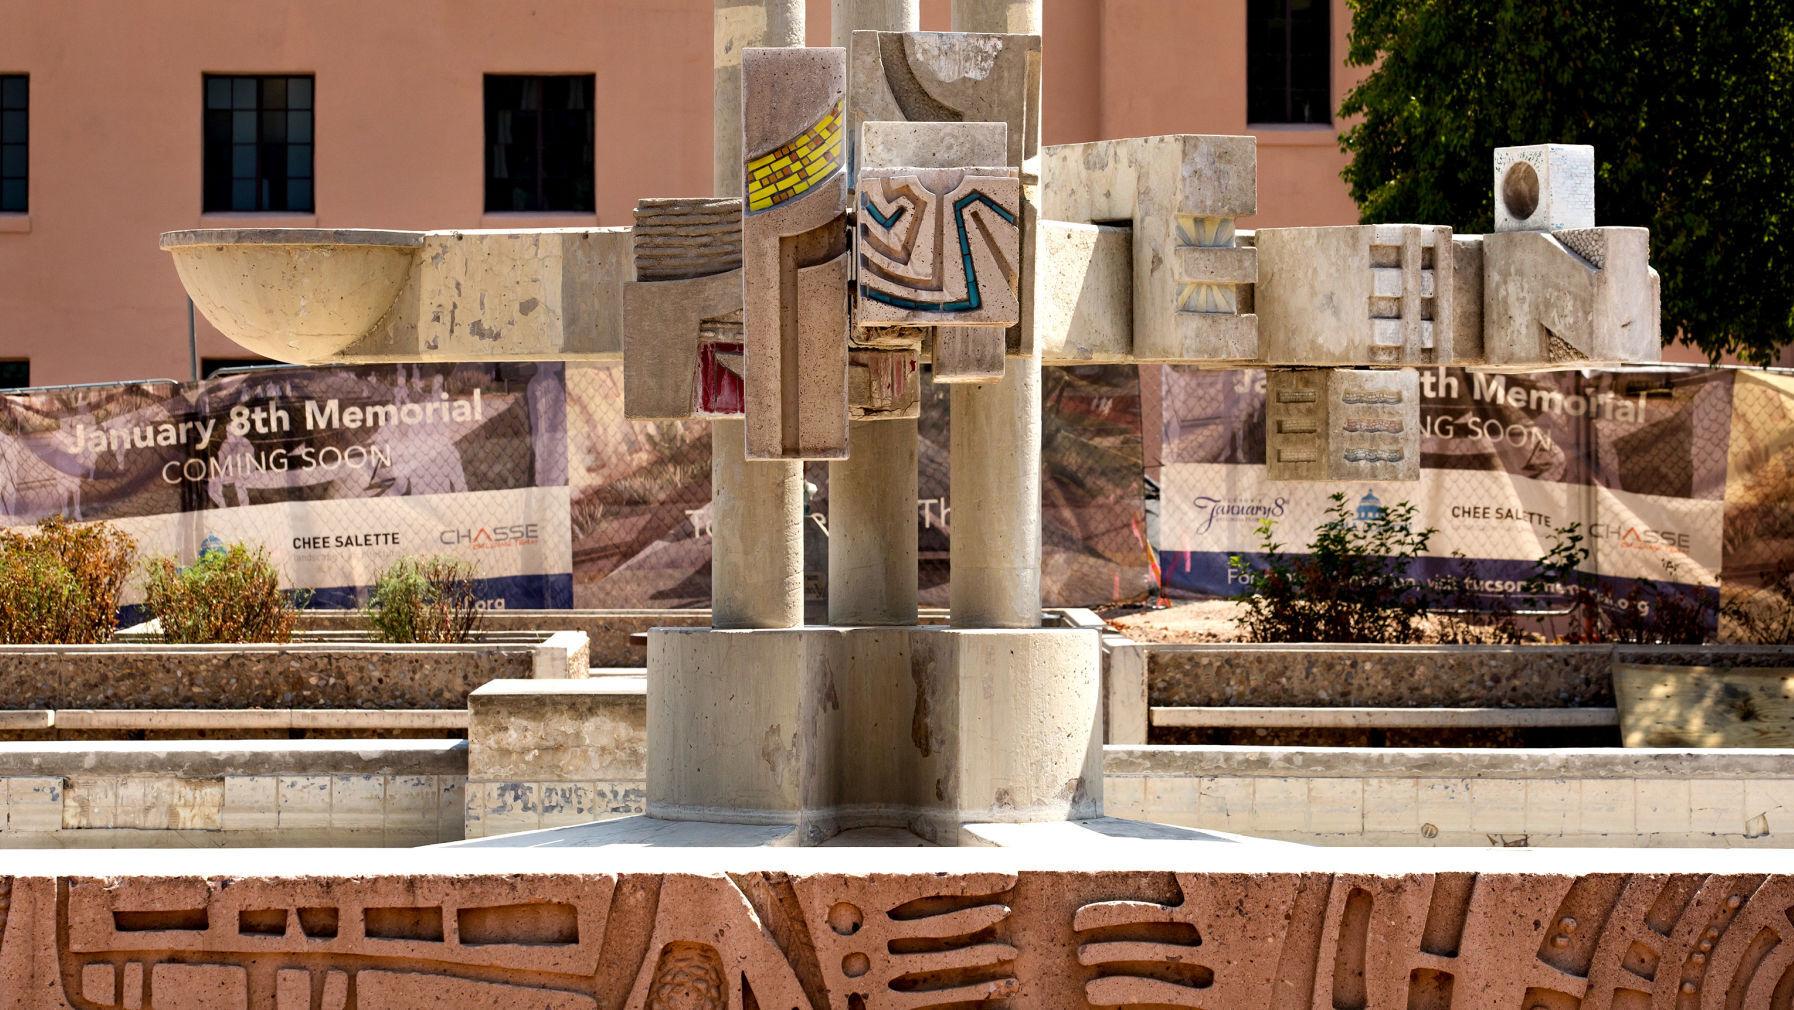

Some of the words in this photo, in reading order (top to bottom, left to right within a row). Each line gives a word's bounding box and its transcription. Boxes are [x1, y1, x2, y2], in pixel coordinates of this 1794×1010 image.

[1473, 371, 1648, 424] Memorial
[70, 418, 216, 455] January
[229, 401, 291, 437] 8th
[304, 388, 483, 431] Memorial
[1467, 416, 1551, 450] SOON
[162, 449, 289, 484] COMING
[301, 443, 392, 470] SOON
[1451, 505, 1491, 519] CHEE
[292, 536, 331, 550] CHEE
[334, 532, 400, 548] SALETTE
[439, 523, 539, 545] CHASSE
[1589, 522, 1690, 549] CHASSE
